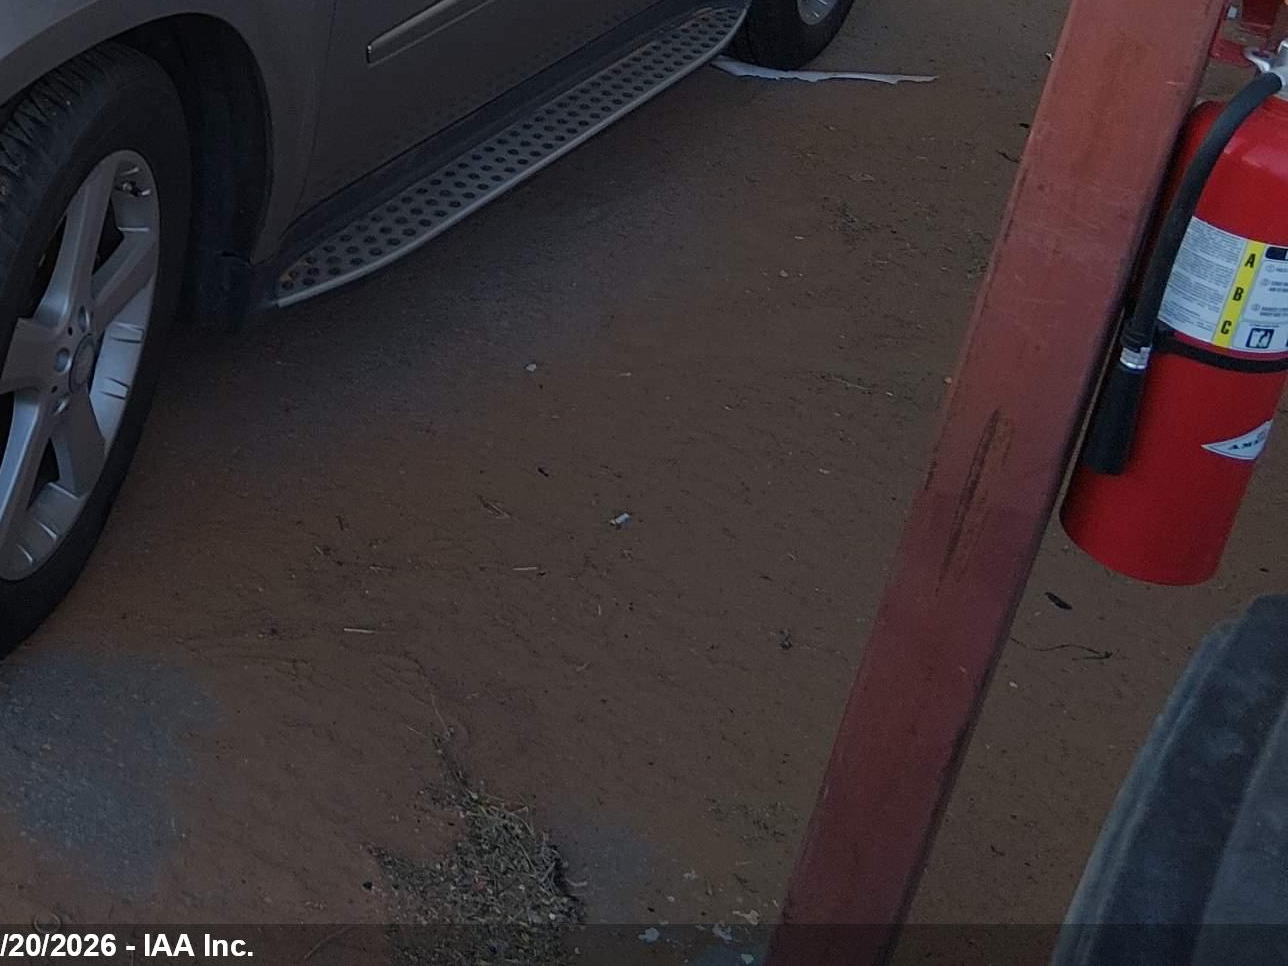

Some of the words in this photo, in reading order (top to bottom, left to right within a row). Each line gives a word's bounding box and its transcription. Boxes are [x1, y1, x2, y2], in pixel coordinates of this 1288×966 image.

[1244, 253, 1257, 269] A
[1232, 286, 1244, 302] B
[1220, 320, 1232, 335] C
